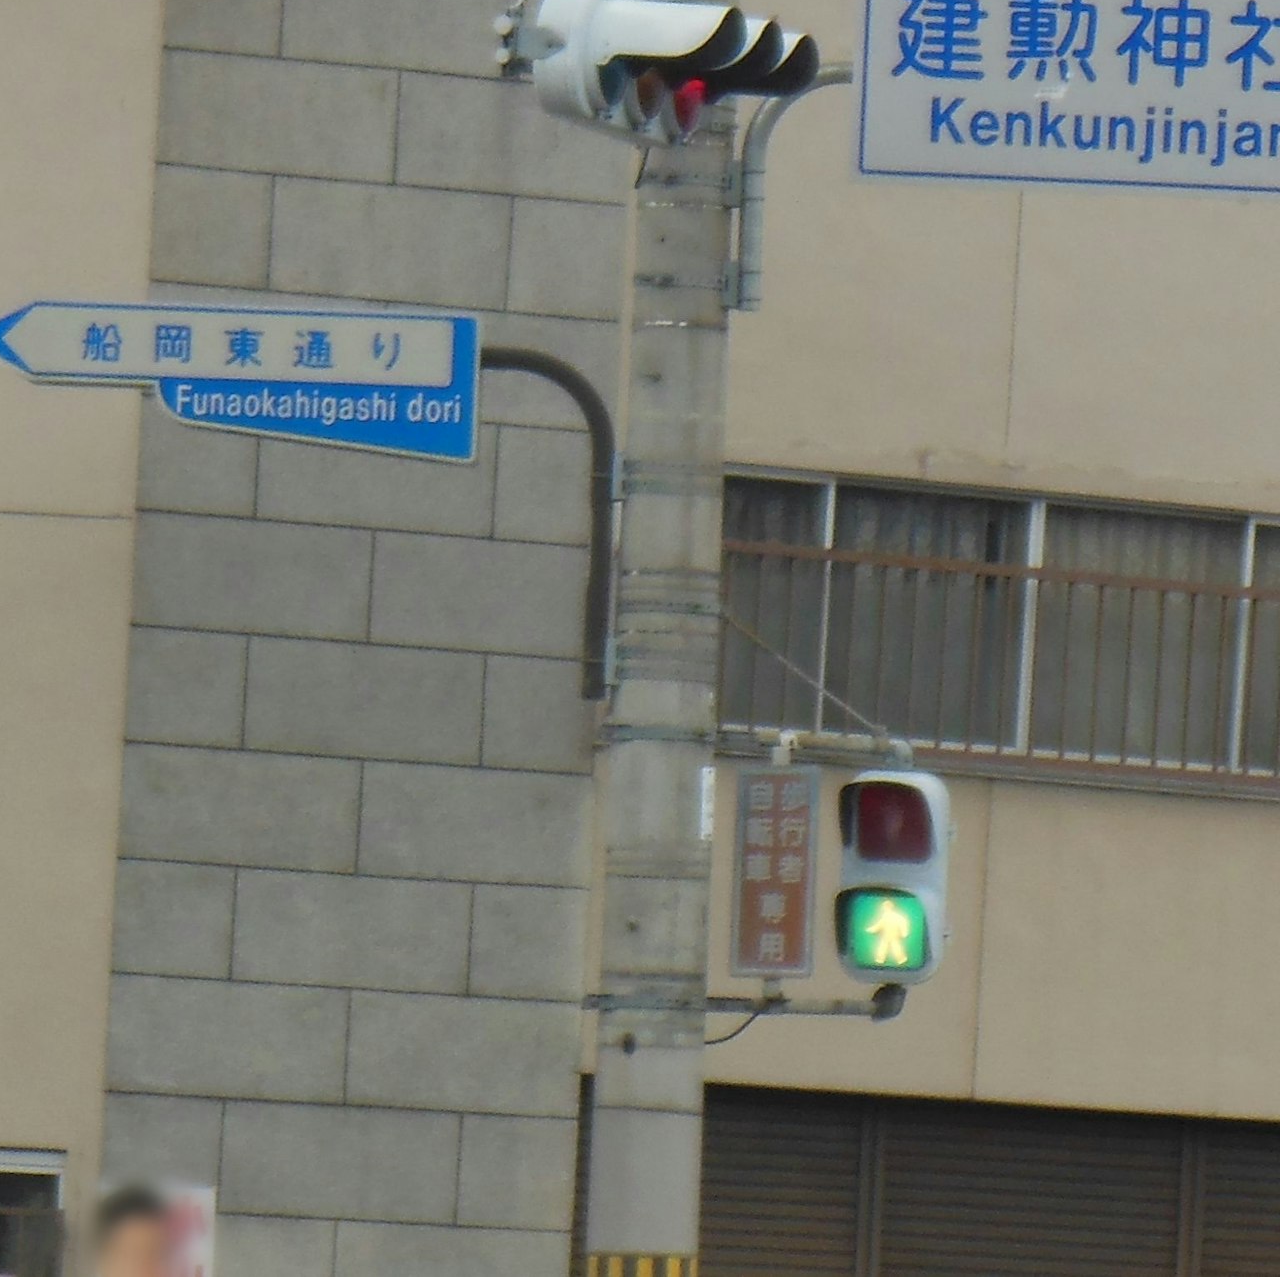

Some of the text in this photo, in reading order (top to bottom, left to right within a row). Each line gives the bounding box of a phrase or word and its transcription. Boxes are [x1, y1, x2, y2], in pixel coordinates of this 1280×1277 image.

[81, 322, 402, 371] 船岡東通り
[176, 384, 462, 426] Funaokahigashi dori
